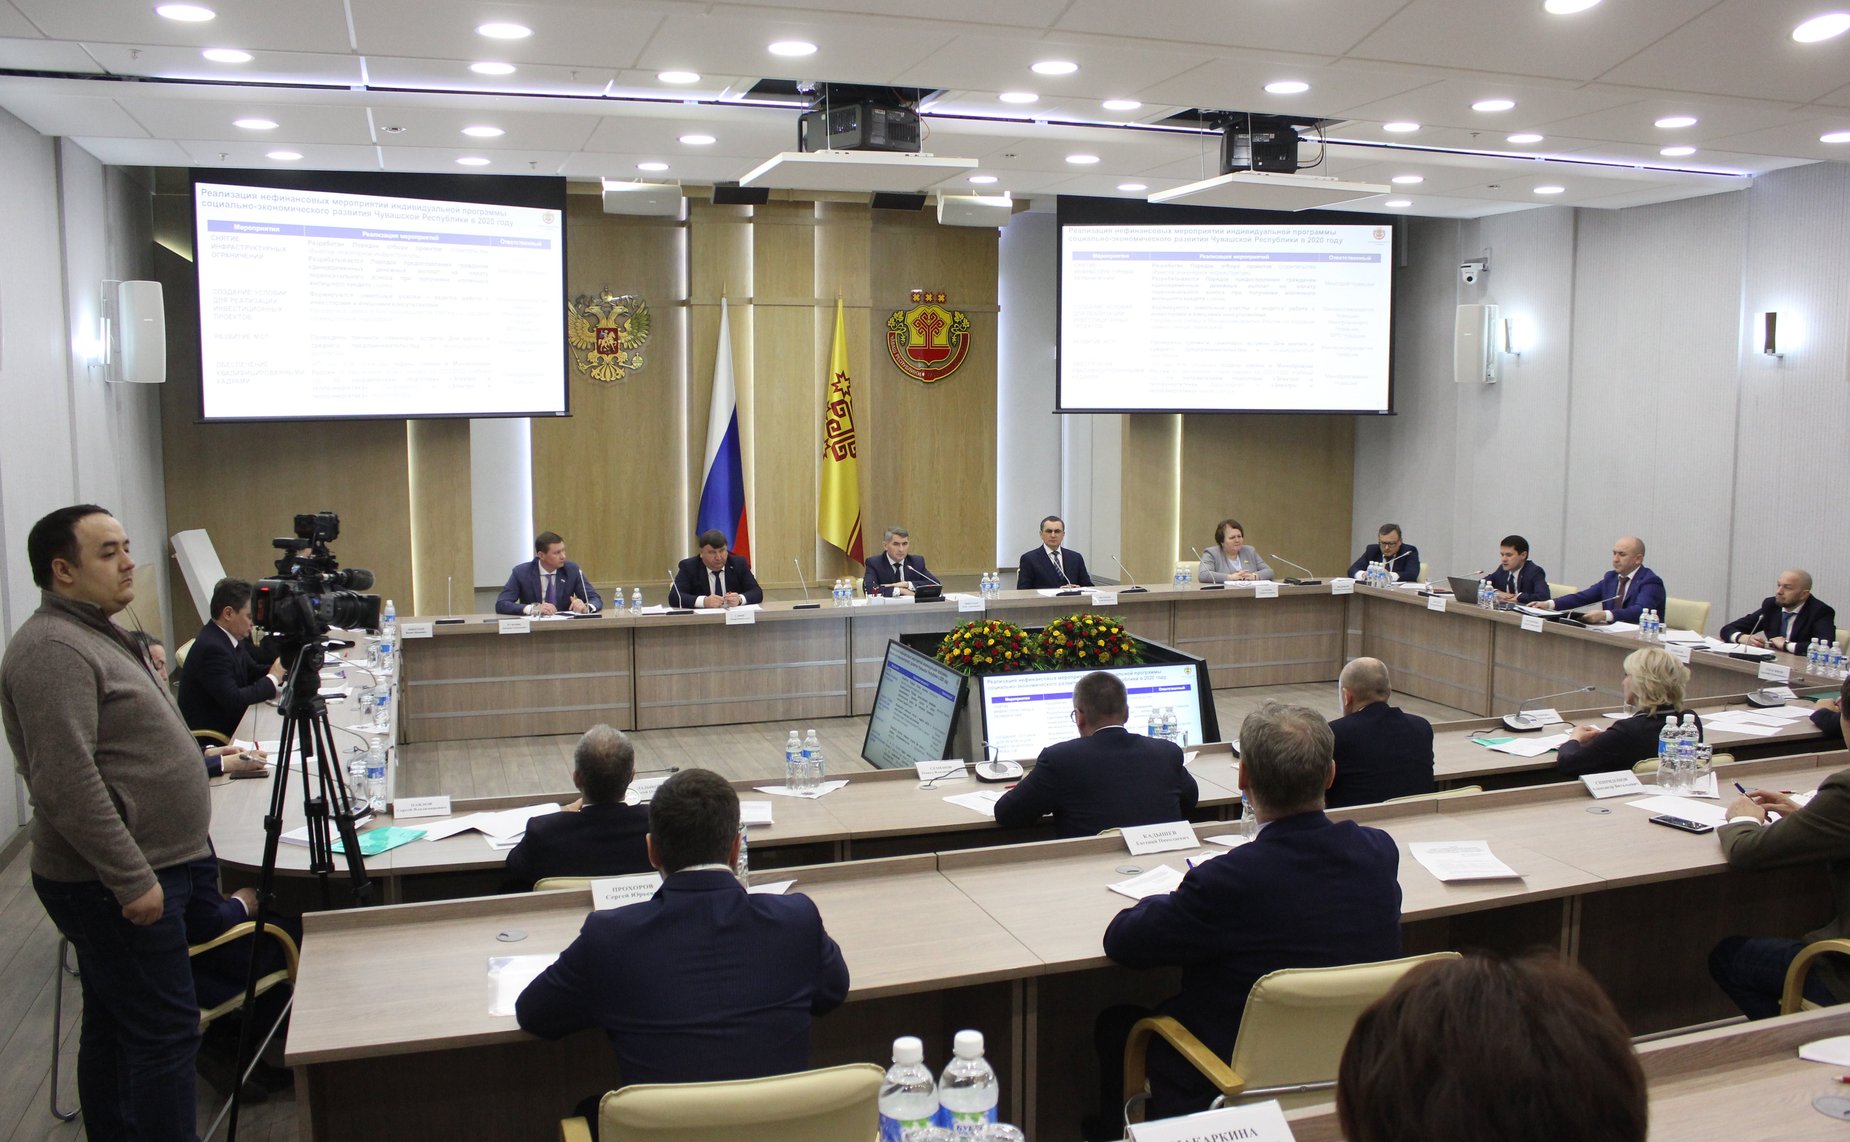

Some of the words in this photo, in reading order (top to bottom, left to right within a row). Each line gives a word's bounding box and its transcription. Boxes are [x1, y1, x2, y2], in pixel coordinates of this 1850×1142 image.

[201, 188, 257, 200] Реализация
[260, 193, 329, 206] нефинансовых
[463, 208, 507, 218] программы
[201, 200, 329, 215] социально-экономического
[332, 208, 372, 218] развития
[374, 211, 419, 220] Чувашской
[422, 213, 469, 224] Республики
[478, 217, 494, 225] 2020
[497, 219, 514, 228] году
[1069, 227, 1112, 236] Реализация
[1115, 228, 1171, 236] нефинансовых
[1293, 229, 1336, 237] программы
[1255, 236, 1298, 244] Республики
[1142, 830, 1177, 839] КАДЫШЕВ
[612, 883, 654, 893] ПРОХОРОВ
[605, 893, 630, 901] Сергей
